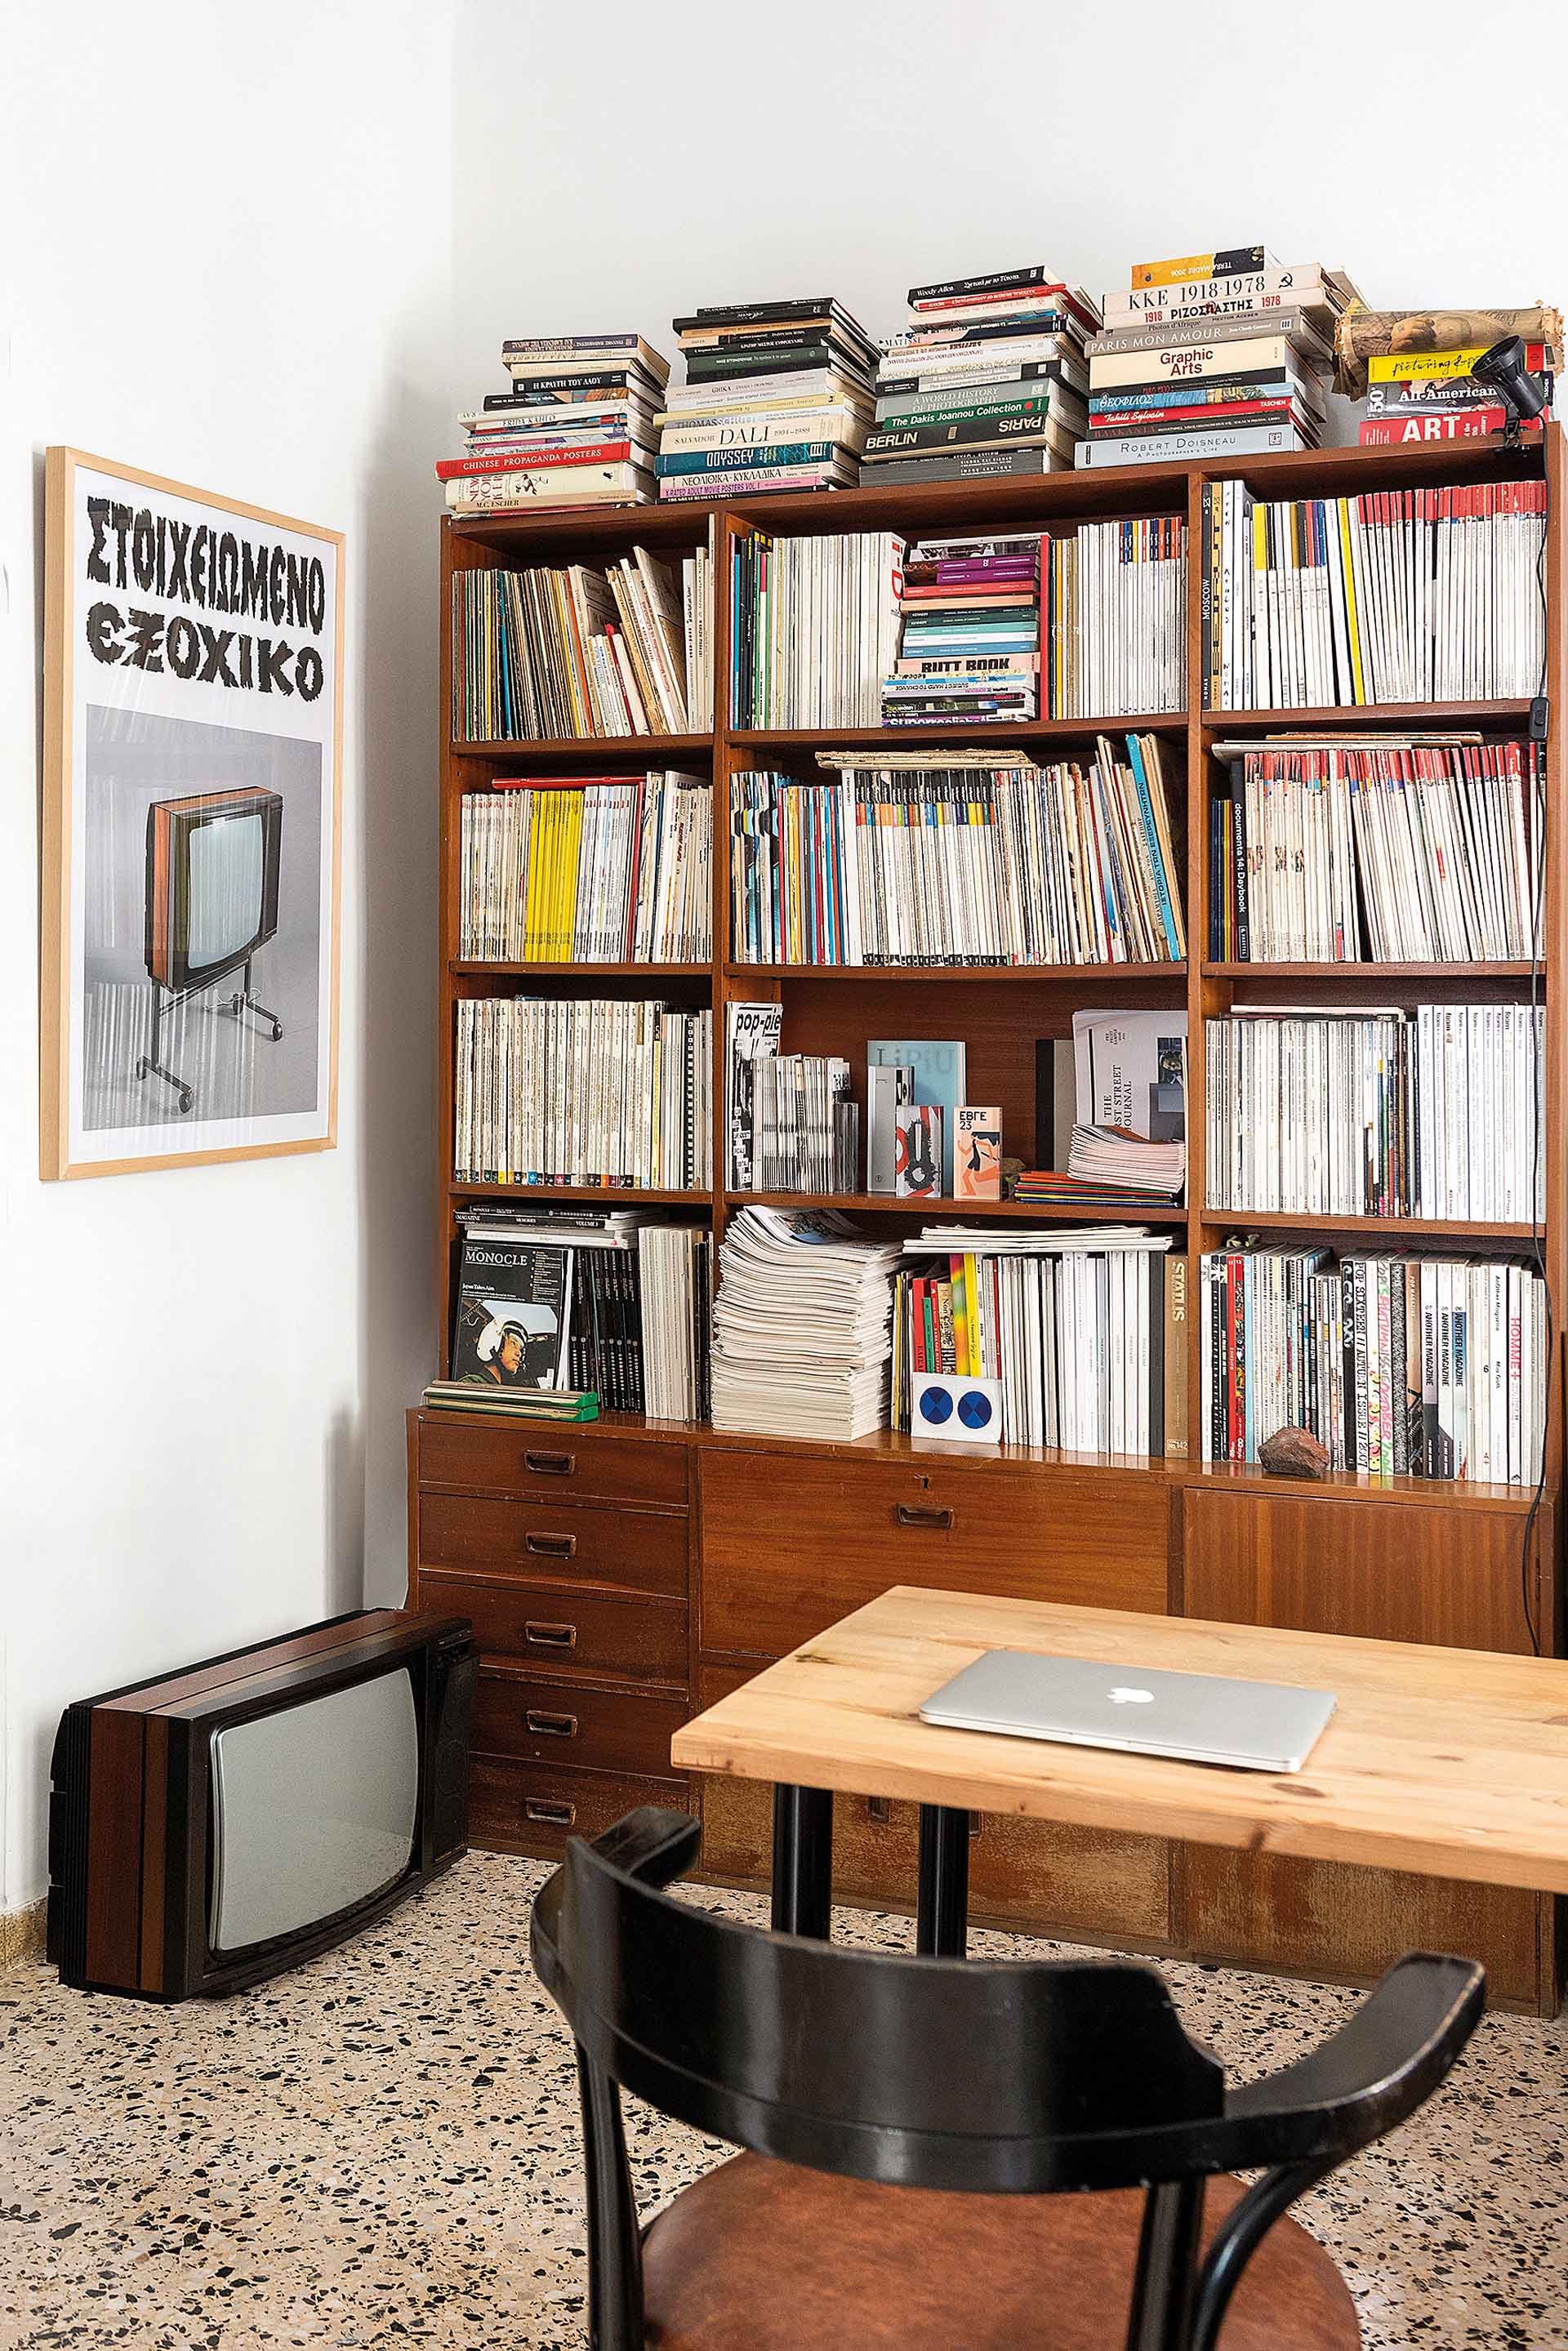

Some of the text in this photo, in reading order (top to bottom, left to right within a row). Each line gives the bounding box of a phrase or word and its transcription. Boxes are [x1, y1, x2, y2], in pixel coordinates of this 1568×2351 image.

[1145, 295, 1281, 323] 1918 ΡΙΖΟΣΠΑΣΤΗΣ 1978
[1090, 327, 1223, 352] PARIS MON AMOUR
[1160, 348, 1214, 365] Graphic
[1392, 358, 1450, 376] picturing
[1169, 363, 1203, 376] Arts
[921, 393, 956, 403] WORLD
[957, 387, 999, 399] HISTORY
[1099, 394, 1154, 407] ΘΕΟΦΙΛΟΣ
[1398, 385, 1498, 403] All-American
[892, 403, 1022, 427] The Dakis Joannou Collection
[998, 416, 1043, 433] PARIS
[674, 435, 715, 444] SALVADOR
[719, 425, 771, 445] DALI
[1402, 415, 1461, 443] ART
[866, 431, 919, 450] BERLIN
[1120, 437, 1236, 453] ROBERT DOISNEAU
[463, 449, 602, 470] CHINESE PROPAGANDA POSTERS
[706, 448, 754, 467] ODYSSEY
[491, 499, 519, 508] ESCHER
[1202, 578, 1210, 621] MOSCOW
[1235, 804, 1243, 857] documenta
[1112, 1064, 1121, 1105] STREET
[1103, 1094, 1111, 1118] THE
[959, 1121, 973, 1130] 23
[465, 1250, 528, 1266] MONOCLE
[1356, 1262, 1365, 1283] POP
[1425, 1311, 1435, 1386] ANOTHER MAGAZINE
[1441, 1312, 1450, 1387] ANOTHER MAGAZINE
[1454, 1312, 1464, 1387] ANOTHER MAGAZINE
[1357, 1394, 1367, 1428] ISSUE
[1358, 1442, 1368, 1467] 2007
